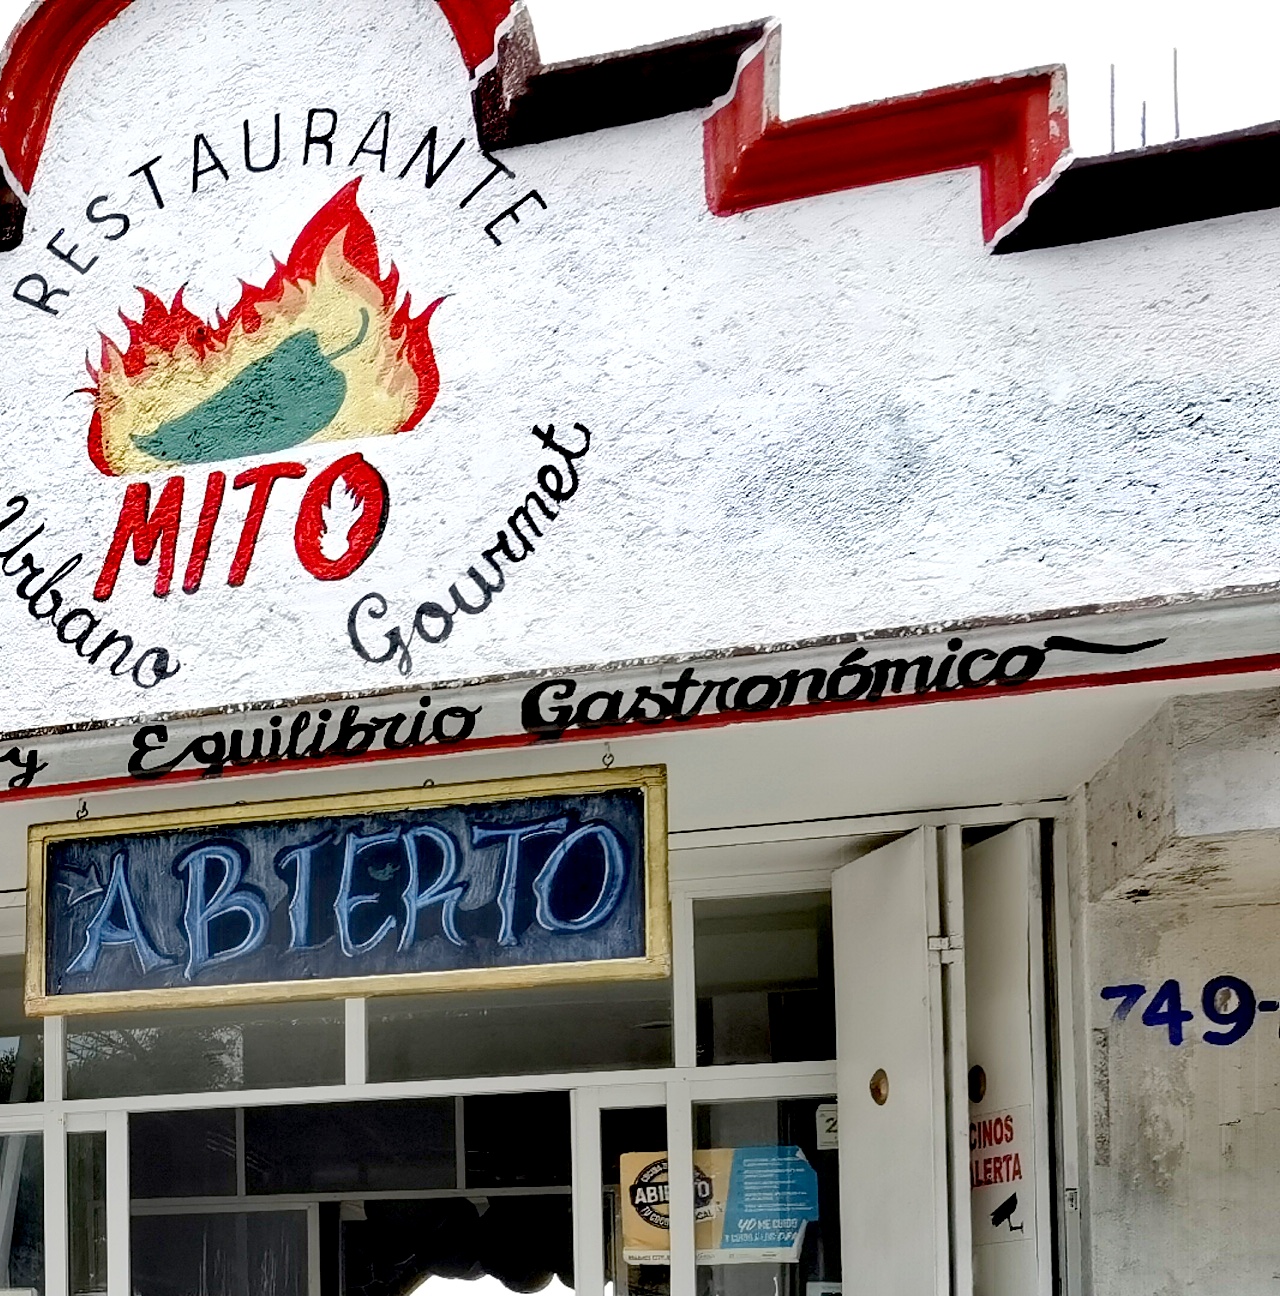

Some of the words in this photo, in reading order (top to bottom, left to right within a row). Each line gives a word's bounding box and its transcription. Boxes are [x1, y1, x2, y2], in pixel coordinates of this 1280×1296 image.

[13, 108, 548, 315] RESTAURANTE
[93, 452, 389, 601] MITO
[347, 421, 591, 675] Gourmet
[128, 695, 482, 779] Equilibrio
[521, 637, 1051, 741] Gastronómico
[64, 815, 628, 981] ABIERTO
[1100, 975, 1280, 1046] 749-
[635, 1181, 711, 1205] ABIO
